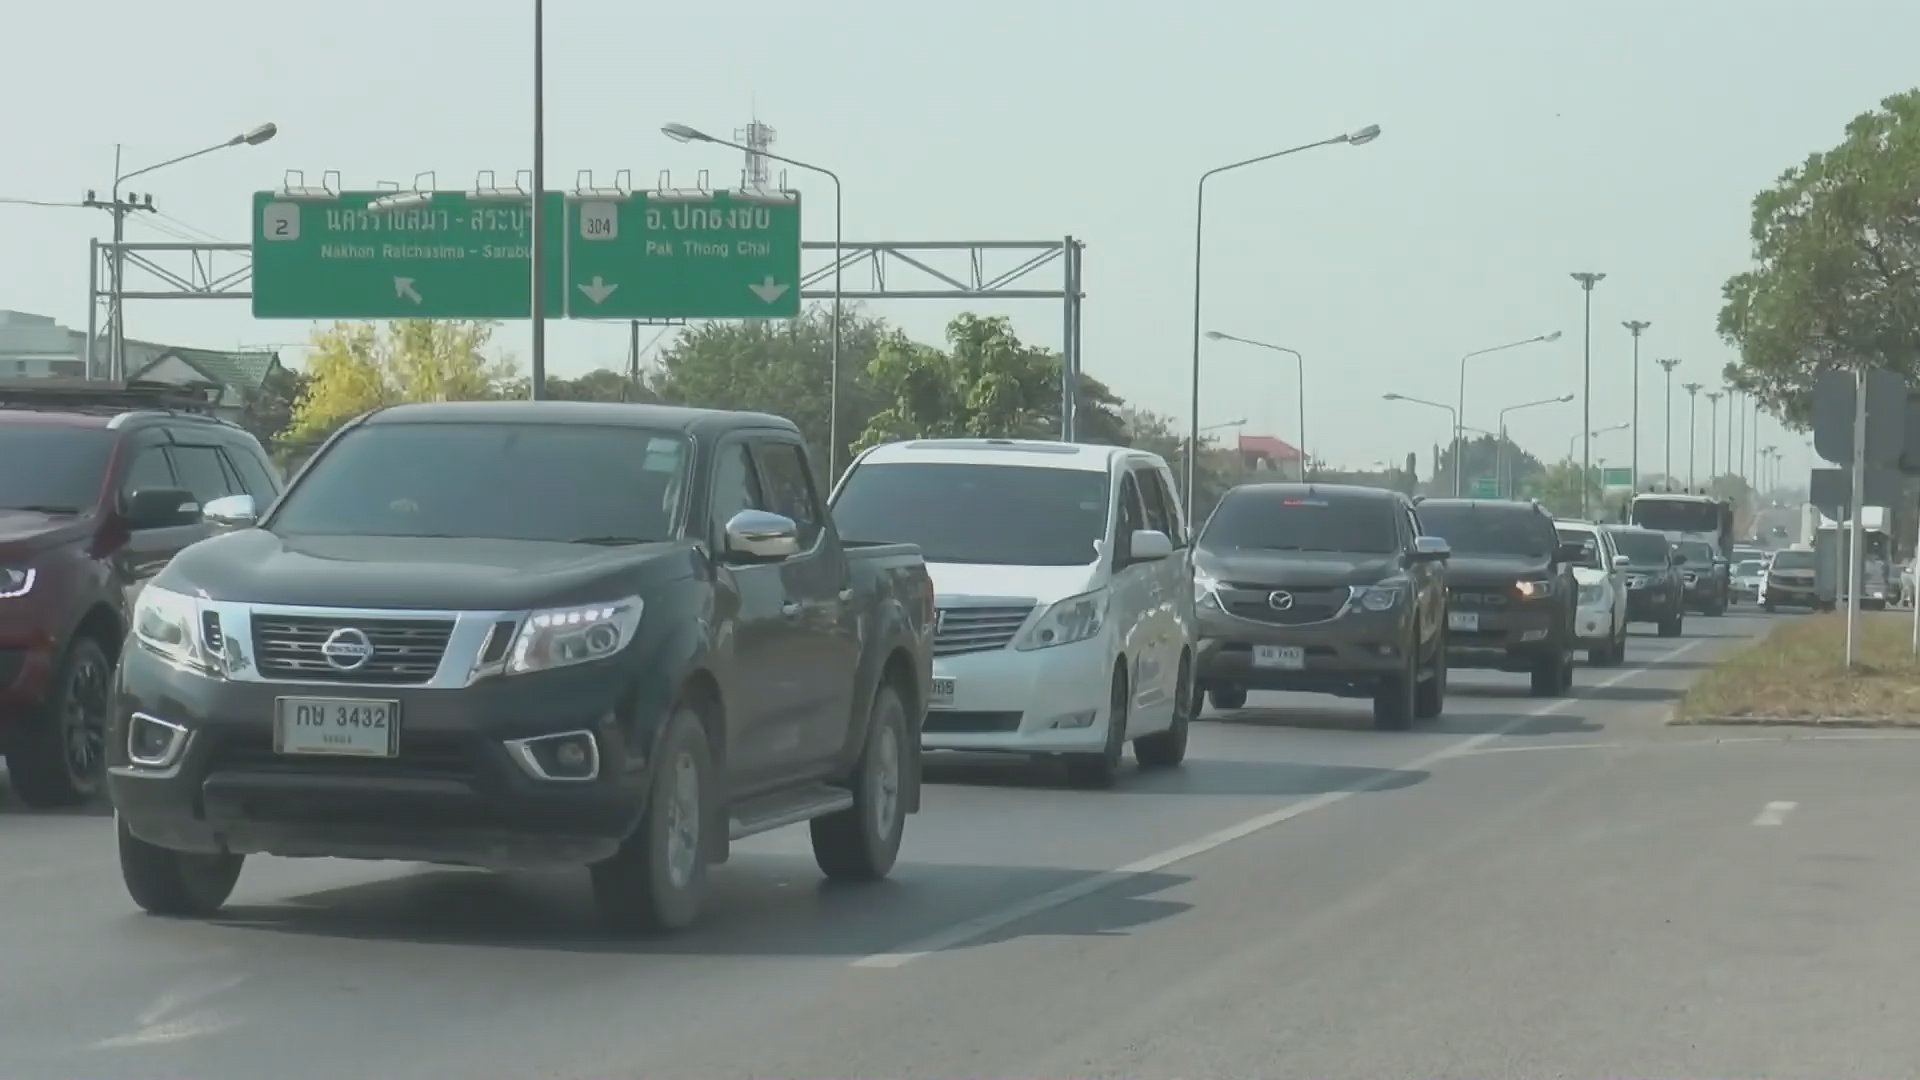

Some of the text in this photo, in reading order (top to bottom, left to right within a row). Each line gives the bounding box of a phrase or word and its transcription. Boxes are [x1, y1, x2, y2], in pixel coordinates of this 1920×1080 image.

[275, 219, 289, 235] 2
[587, 217, 611, 235] 304
[321, 243, 374, 258] Nakhon
[382, 243, 465, 258] Ratchasima
[646, 240, 770, 258] Pak Thong Chai
[336, 707, 386, 729] 3432
